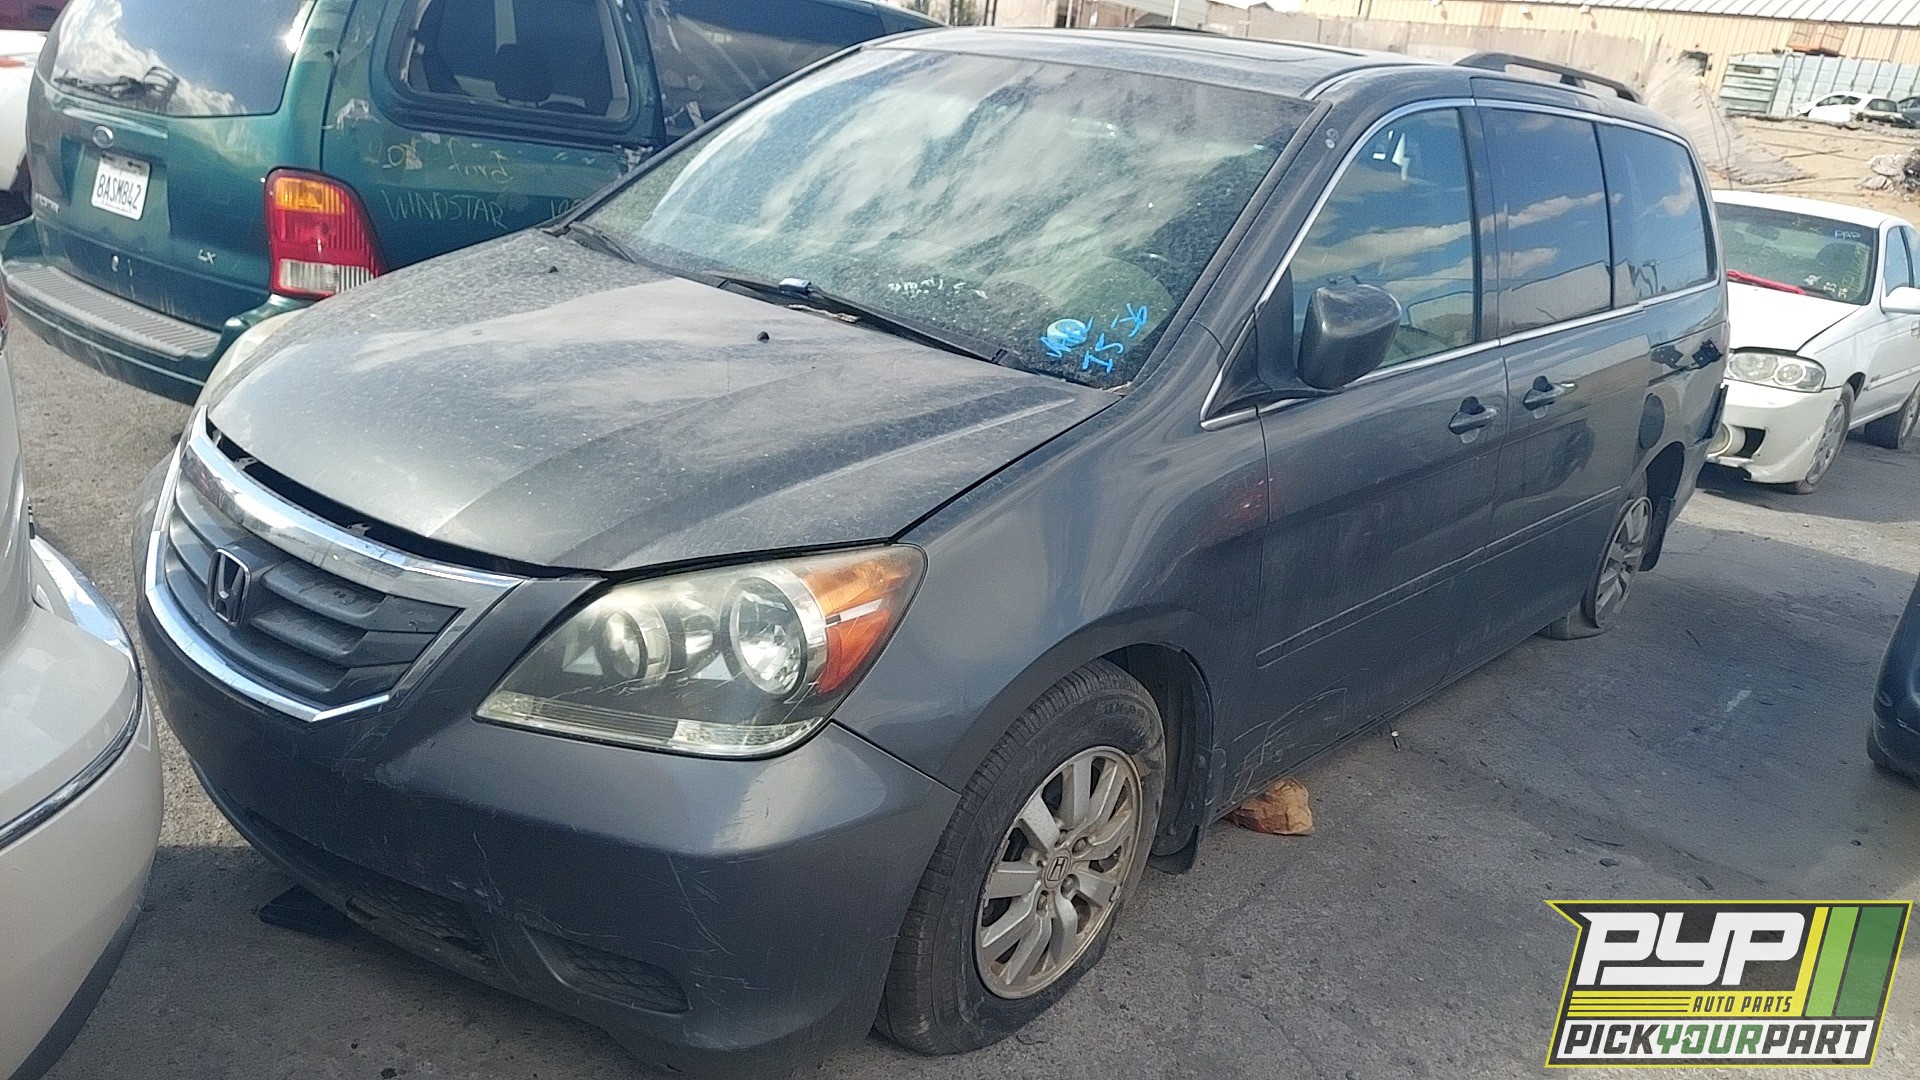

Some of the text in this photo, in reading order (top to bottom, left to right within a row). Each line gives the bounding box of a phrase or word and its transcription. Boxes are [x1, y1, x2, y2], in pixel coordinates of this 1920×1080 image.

[96, 173, 142, 211] 8ASM842
[381, 189, 507, 229] WINDSTAR
[198, 249, 216, 265] LX
